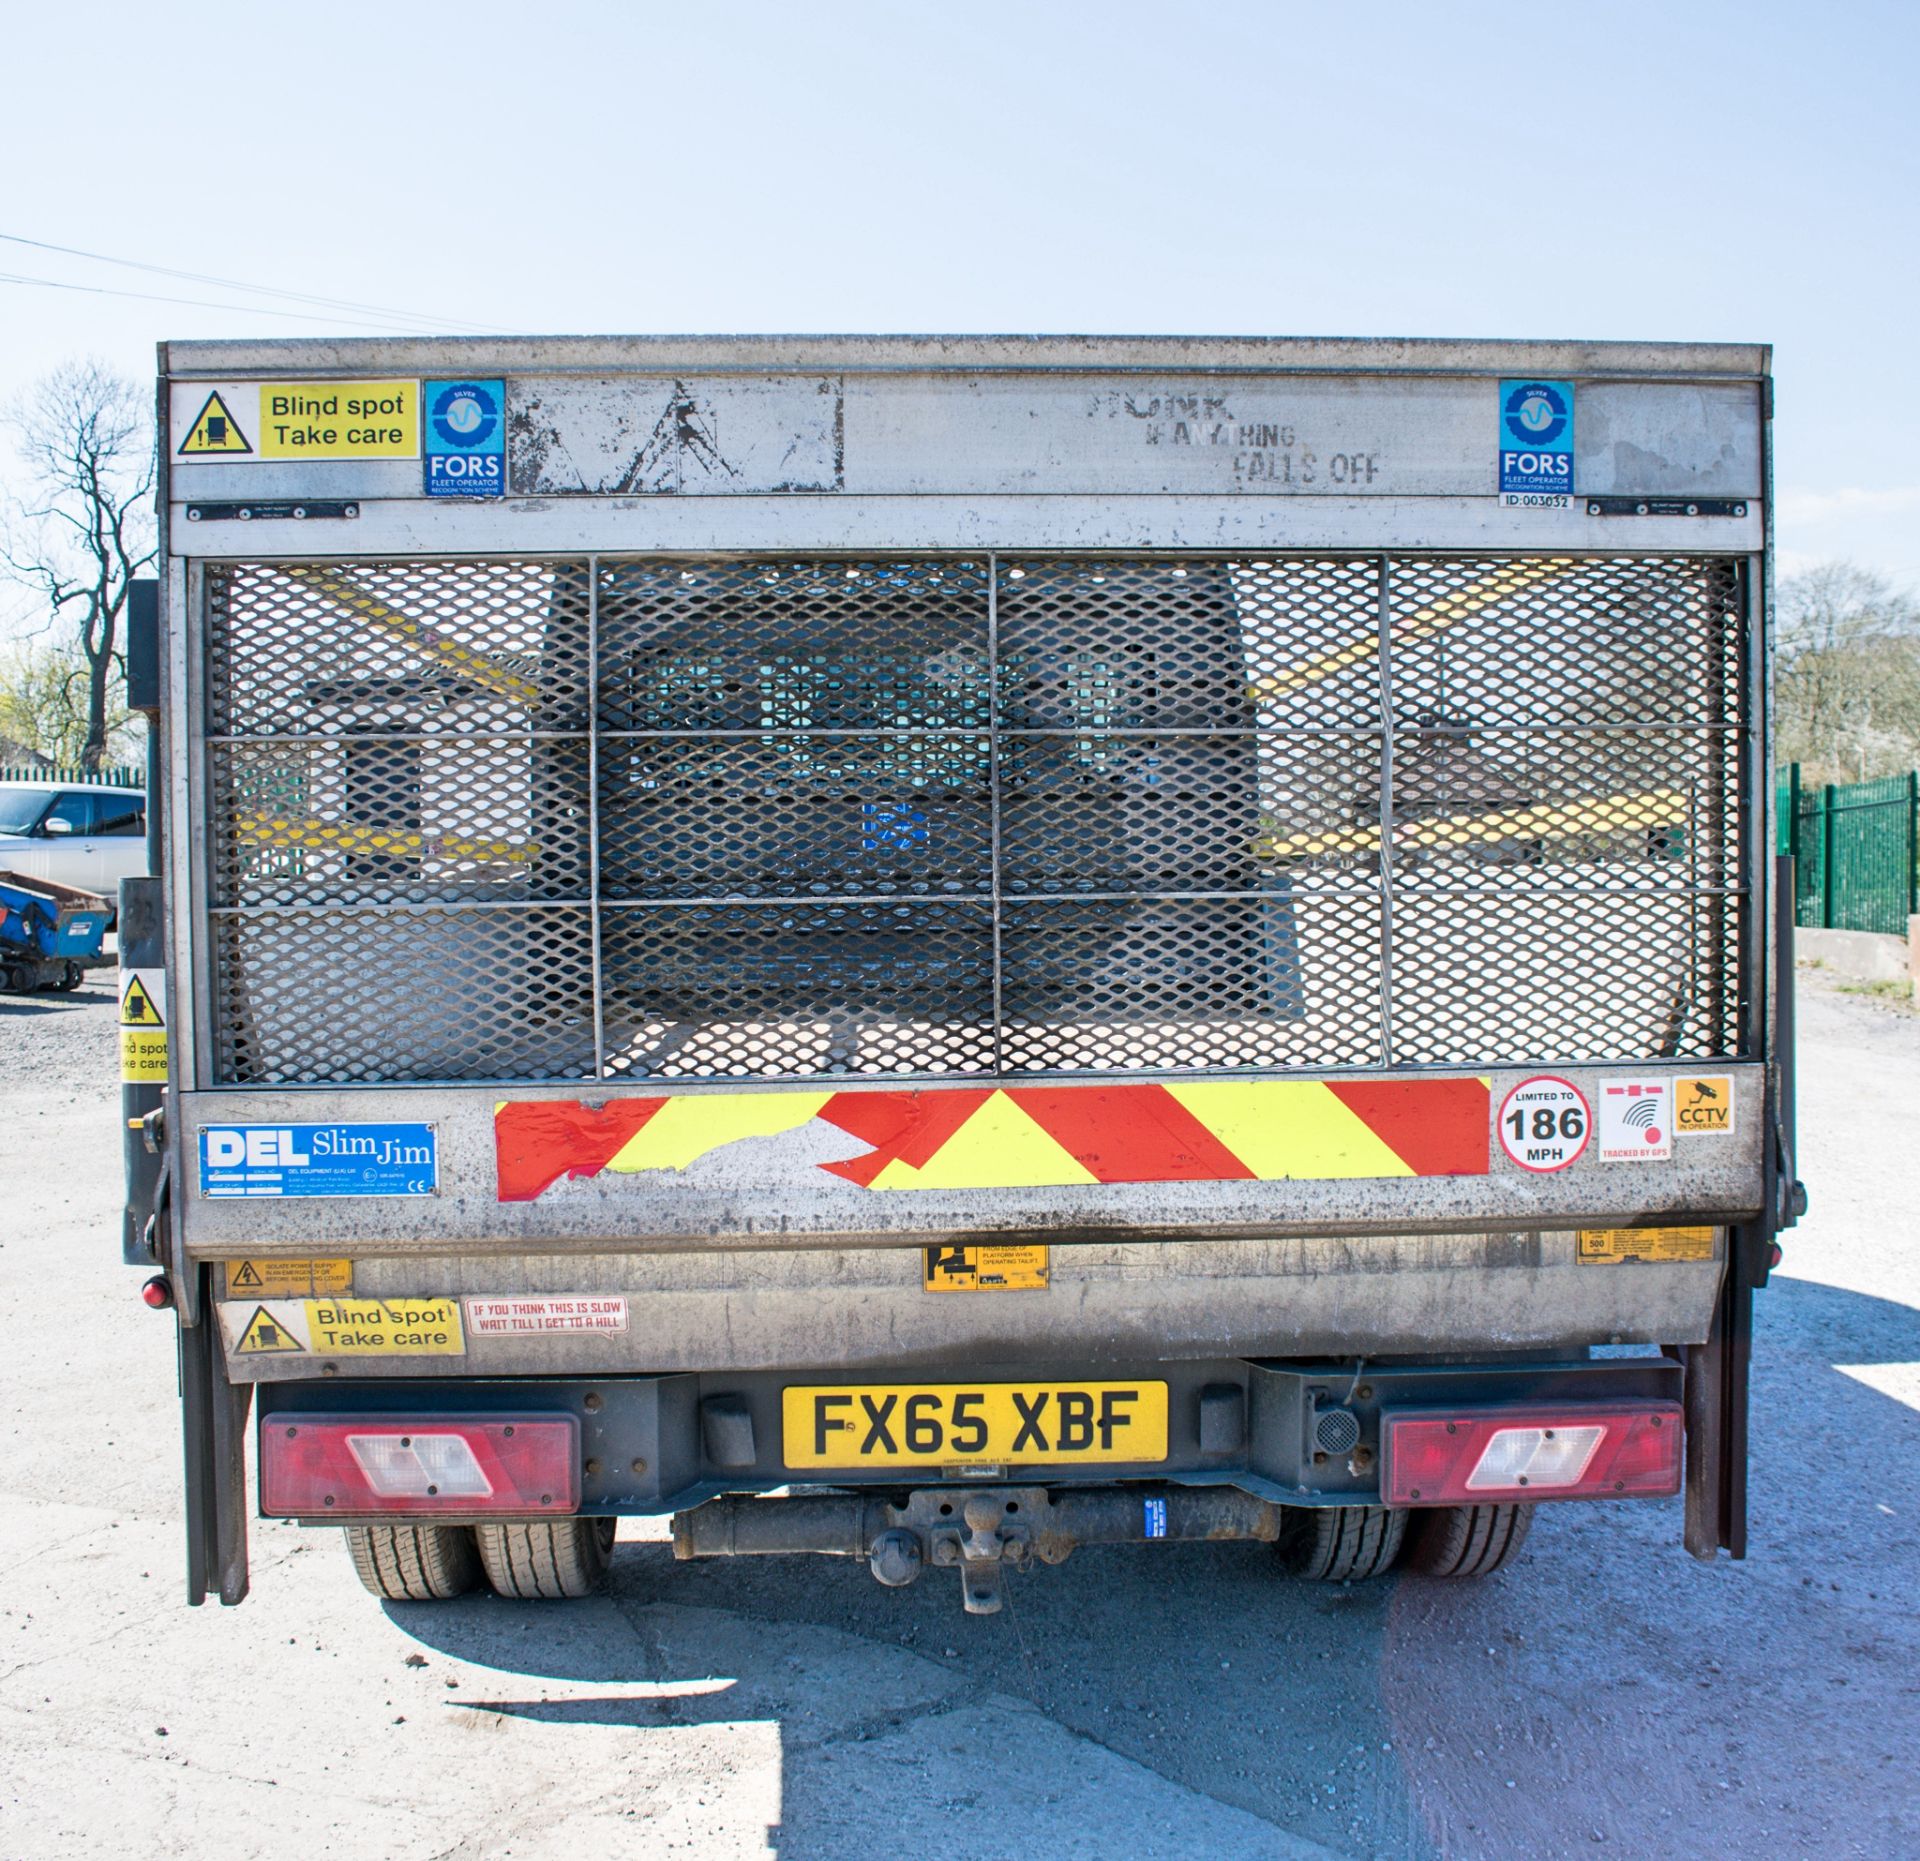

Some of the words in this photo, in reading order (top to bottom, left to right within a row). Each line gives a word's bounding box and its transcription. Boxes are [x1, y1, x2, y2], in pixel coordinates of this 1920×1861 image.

[454, 390, 476, 398] SILVER
[1526, 390, 1548, 398] SILVER
[271, 395, 338, 416] Blind
[347, 395, 404, 420] spot
[274, 426, 338, 446] Take
[346, 427, 403, 445] care
[1174, 421, 1295, 448] ANYTHING
[430, 455, 500, 478] FORS
[1232, 451, 1317, 483] FALLS
[1329, 452, 1380, 484] OFF
[1504, 452, 1570, 476] FORS
[431, 479, 455, 487] FLEET
[456, 478, 500, 487] OPERATOR
[1504, 476, 1527, 484] FLEET
[1528, 476, 1569, 485] OPERATOR
[1505, 494, 1568, 508] ID:003032
[139, 1044, 168, 1056] spot
[139, 1060, 168, 1069] care
[1515, 1092, 1557, 1102] LIMITED
[1560, 1091, 1574, 1100] TO
[1679, 1107, 1728, 1124] CCTV
[1505, 1107, 1584, 1141] 186
[1687, 1122, 1729, 1130] OPERATION
[207, 1130, 310, 1167] DEL
[312, 1129, 378, 1156] Slim
[376, 1138, 432, 1165] Jim
[1527, 1147, 1563, 1161] MPH
[1602, 1148, 1639, 1158] TRACKED
[1640, 1148, 1650, 1157] BY
[1651, 1147, 1668, 1157] GPS
[1589, 1239, 1605, 1248] 500
[474, 1304, 484, 1316] IF
[487, 1304, 509, 1316] YOU
[512, 1304, 546, 1315] THINK
[549, 1303, 574, 1314] THIS
[577, 1302, 588, 1313] IS
[591, 1302, 621, 1313] SLOW
[317, 1308, 382, 1325] Blind
[390, 1307, 446, 1327] spot
[479, 1319, 507, 1330] WAIT
[511, 1318, 535, 1329] TILL
[537, 1318, 543, 1329] I
[545, 1318, 566, 1328] GET
[568, 1318, 582, 1328] TO
[585, 1317, 593, 1328] A
[596, 1317, 620, 1328] HILL
[322, 1331, 385, 1346] Take
[393, 1331, 448, 1346] care
[814, 1392, 989, 1456] FX65
[1011, 1390, 1139, 1452] XBF
